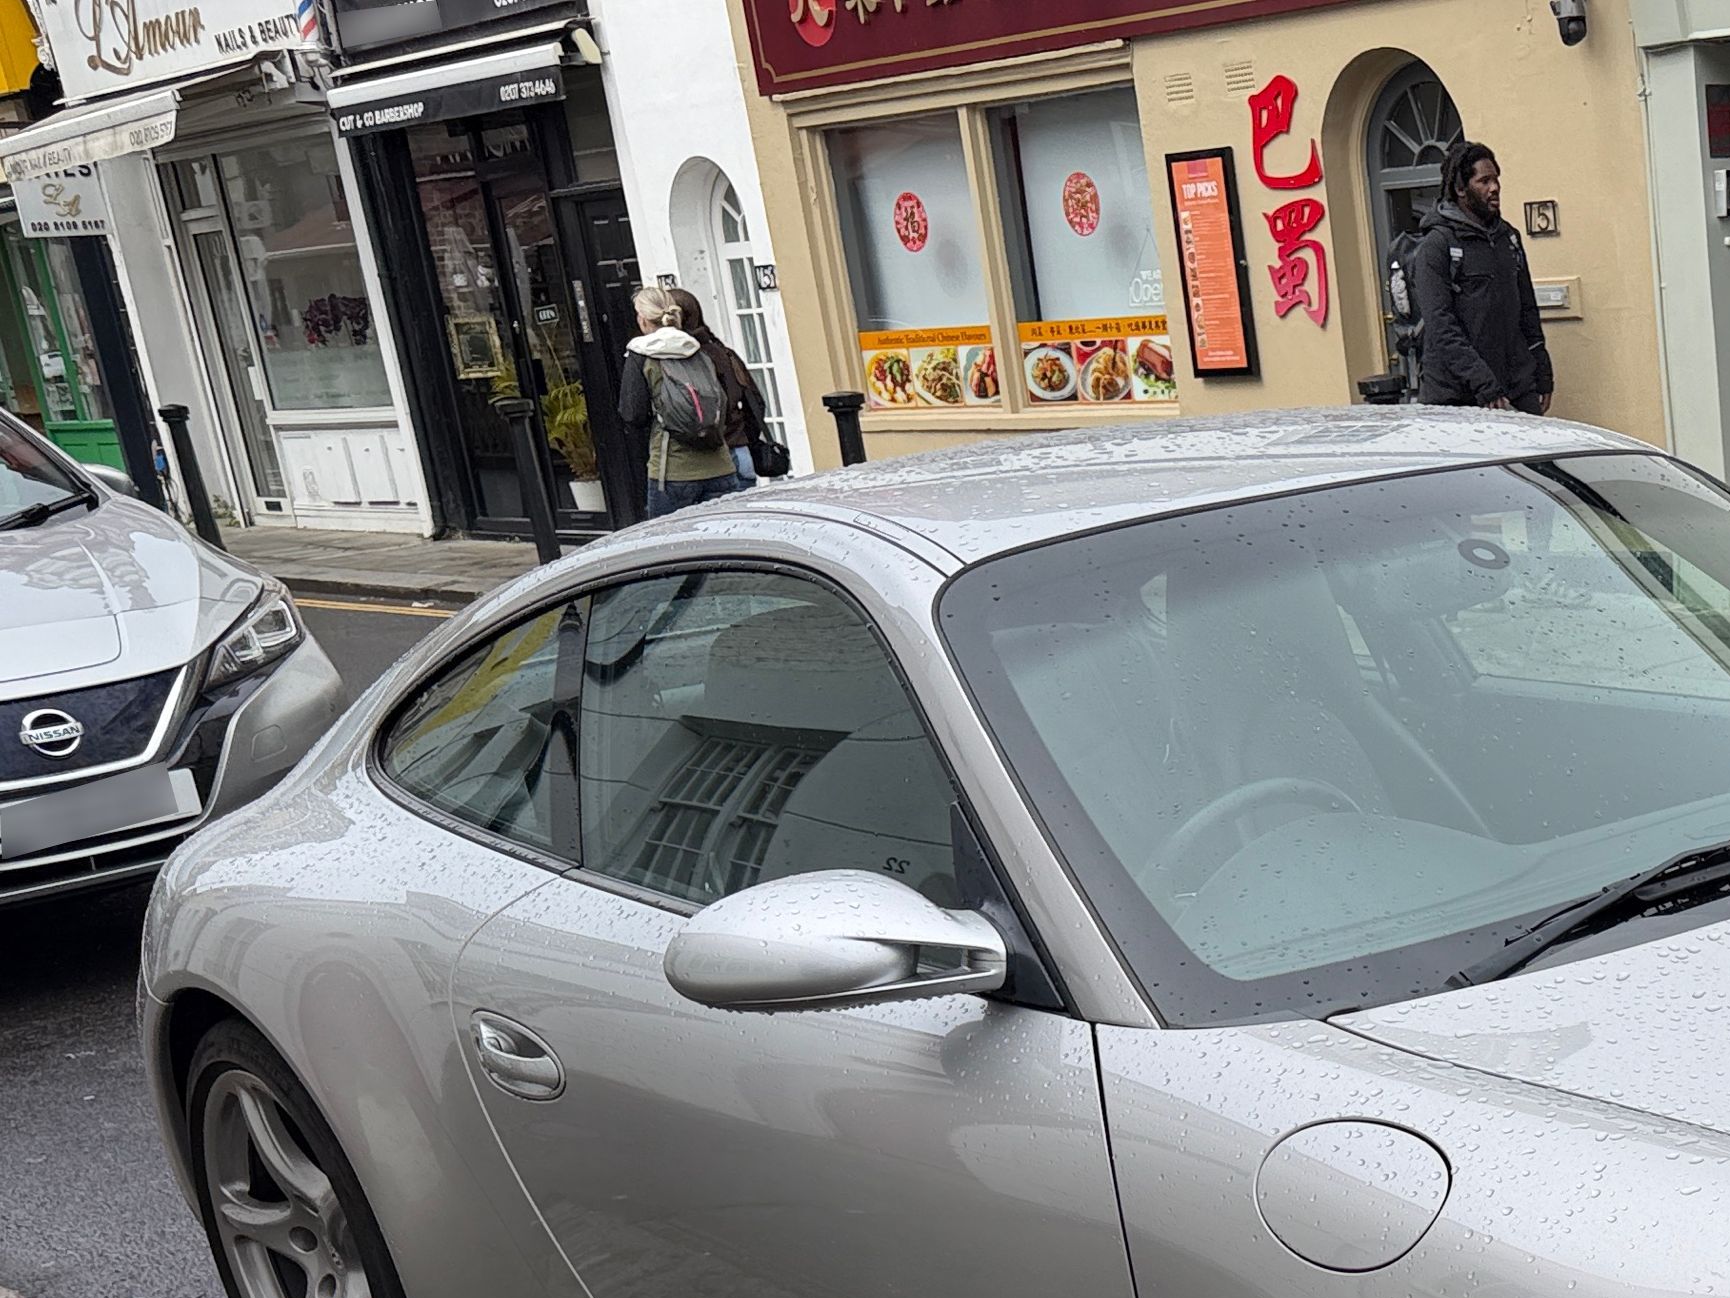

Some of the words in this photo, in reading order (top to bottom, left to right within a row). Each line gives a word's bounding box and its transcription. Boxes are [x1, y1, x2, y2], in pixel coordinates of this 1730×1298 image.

[74, 0, 206, 76] LAmour
[214, 27, 249, 54] NAILS
[248, 25, 259, 47] &
[257, 13, 300, 44] BEAUTY
[339, 115, 355, 131] CUT
[356, 114, 363, 128] &
[363, 111, 374, 127] CO
[374, 101, 425, 125] BARBERSHOP
[1182, 184, 1197, 199] TOP
[1196, 181, 1219, 198] PICKS
[1248, 75, 1328, 330] 巴蜀
[1131, 278, 1164, 303] Ope
[28, 726, 81, 741] NISSAN
